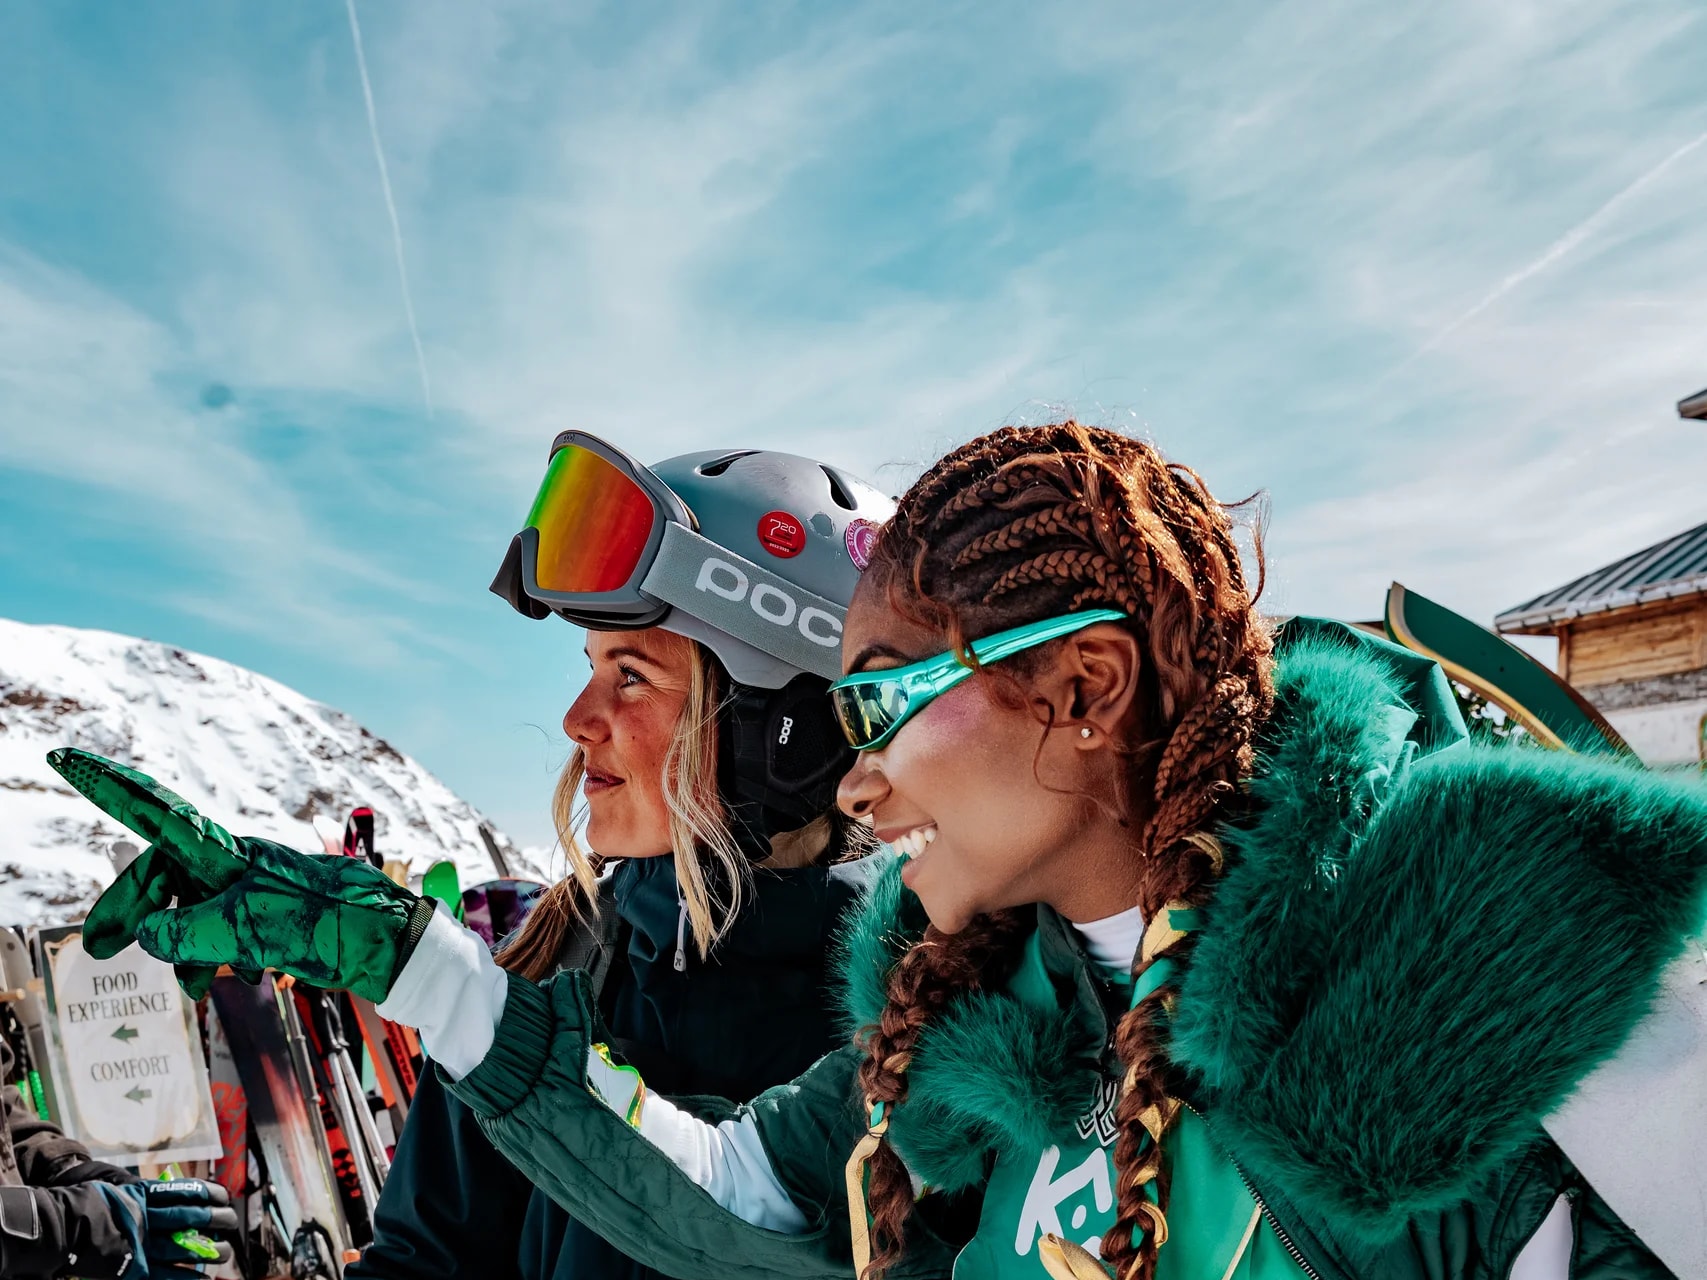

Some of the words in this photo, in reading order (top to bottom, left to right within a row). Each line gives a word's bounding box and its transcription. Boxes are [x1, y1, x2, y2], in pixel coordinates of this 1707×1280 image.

[769, 518, 797, 536] 720
[92, 972, 138, 996] FOOD
[67, 991, 173, 1023] EXPERIENCE
[90, 1055, 171, 1082] COMFORT
[150, 1181, 203, 1193] reusch
